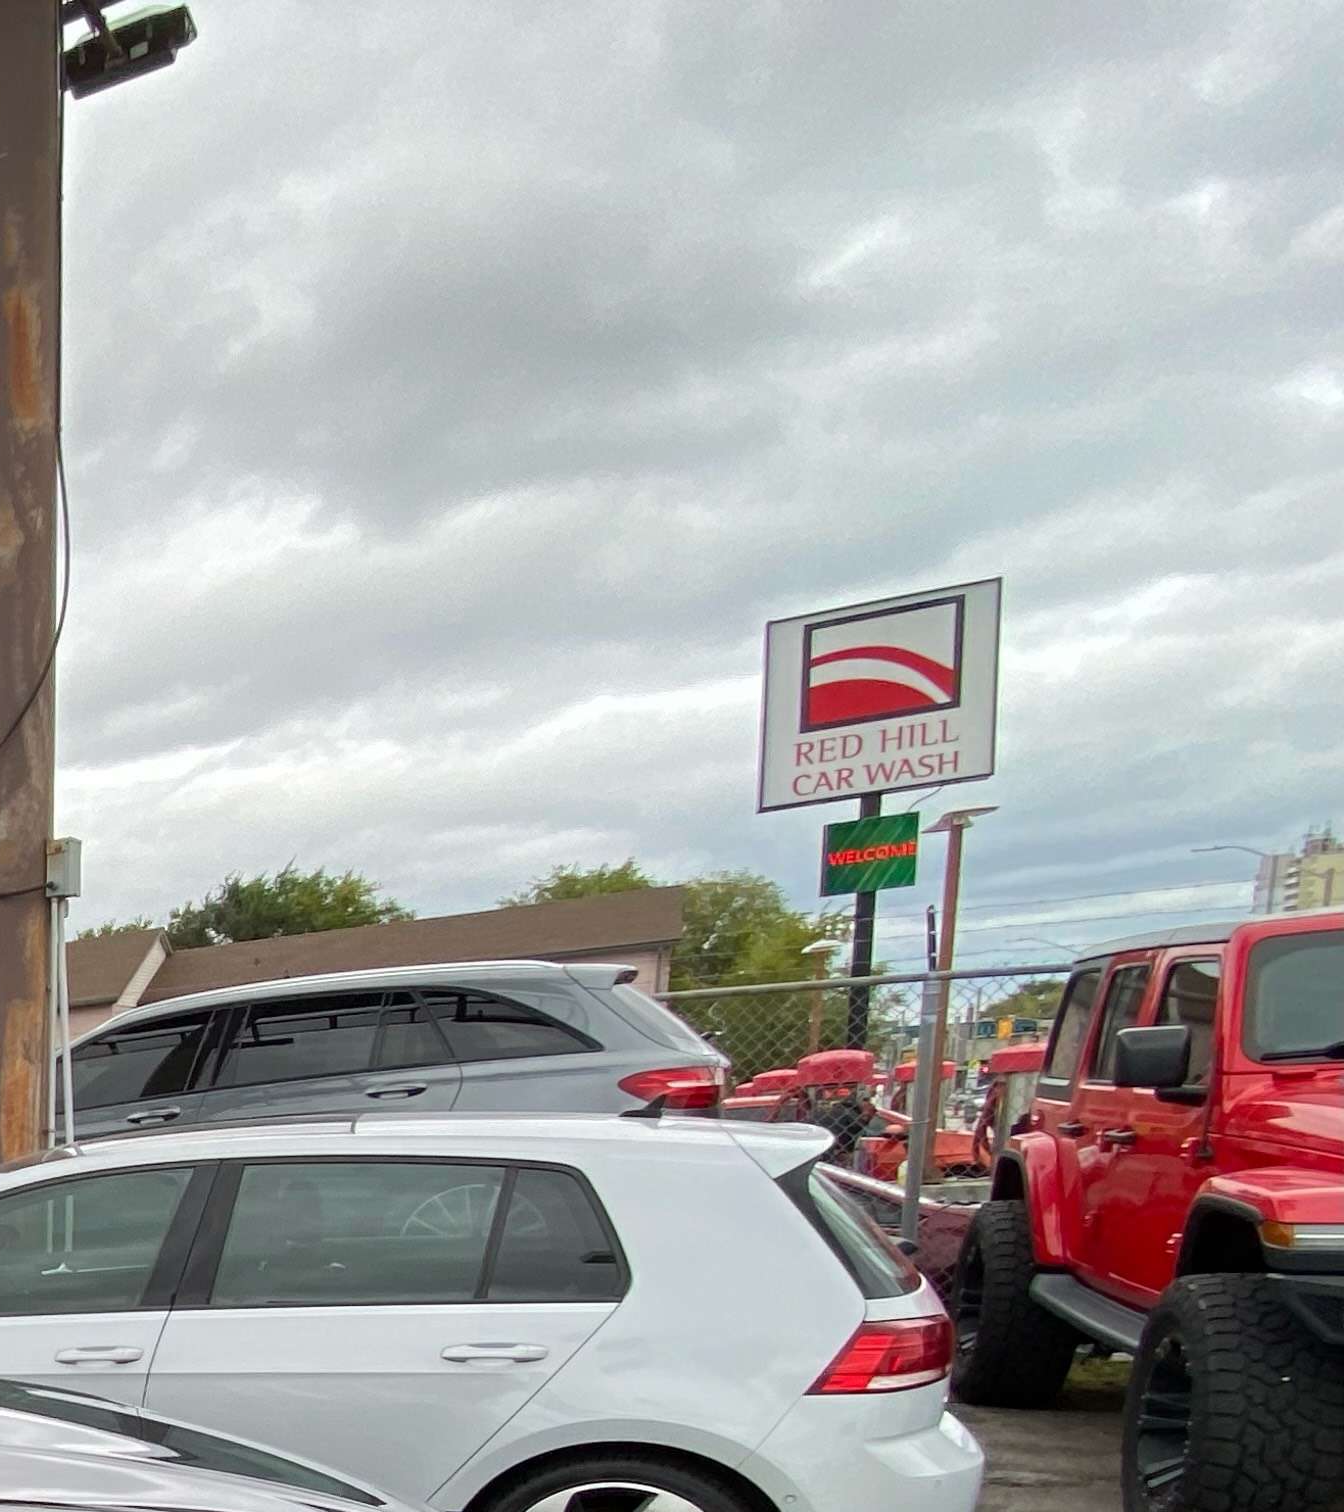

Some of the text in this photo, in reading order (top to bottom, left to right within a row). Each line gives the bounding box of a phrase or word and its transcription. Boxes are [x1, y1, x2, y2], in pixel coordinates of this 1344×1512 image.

[793, 719, 960, 767] RED HILL
[792, 751, 961, 796] CAR WASH
[828, 841, 918, 866] WELCOME
